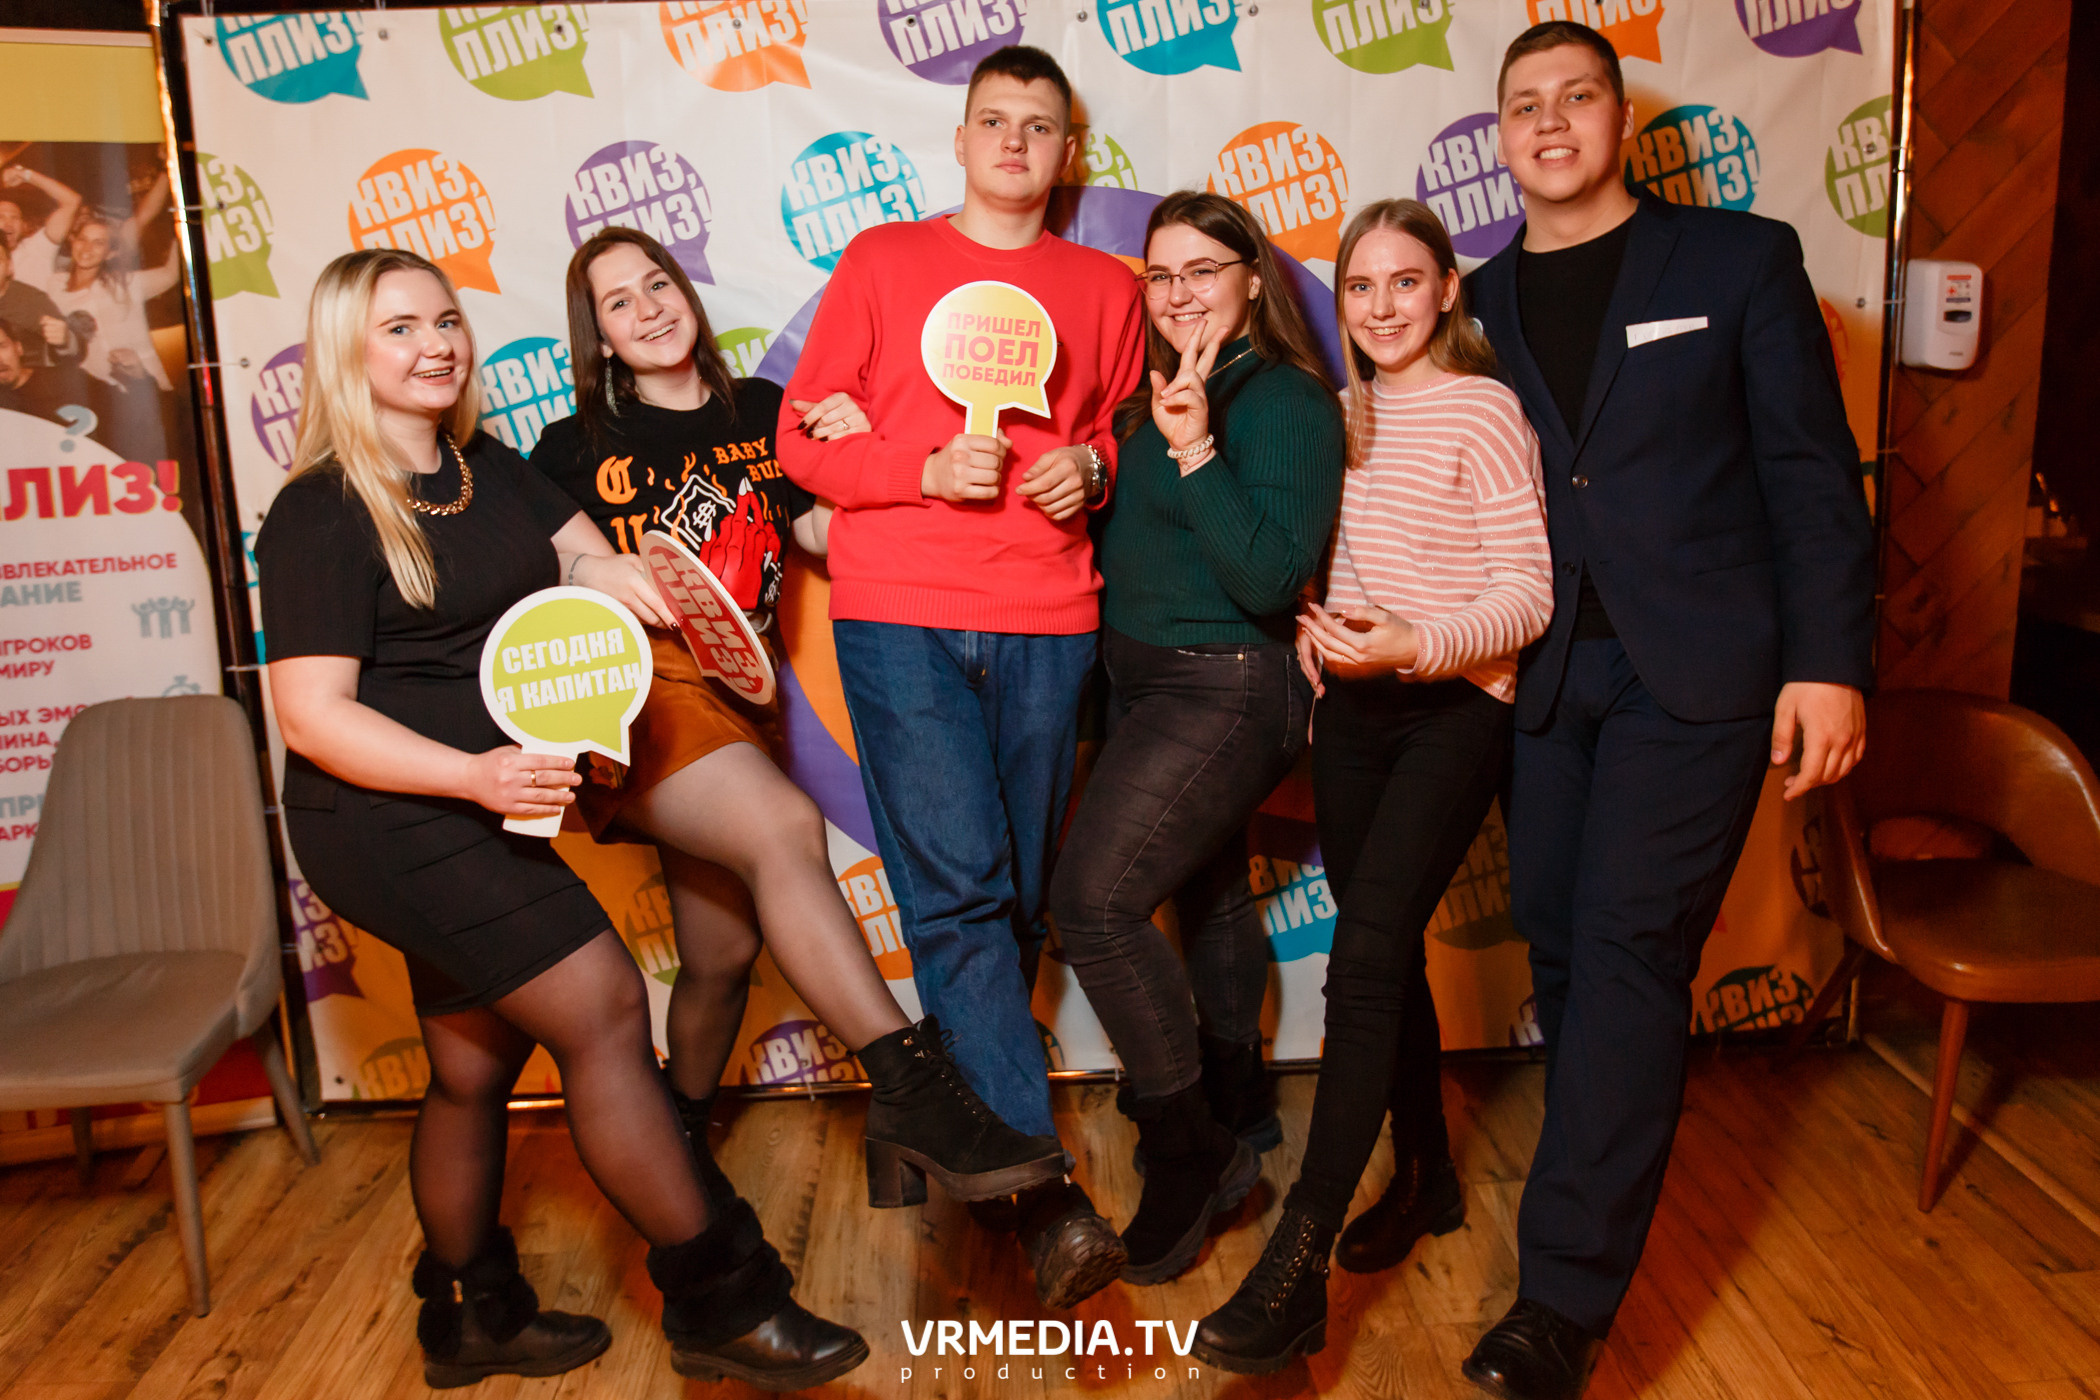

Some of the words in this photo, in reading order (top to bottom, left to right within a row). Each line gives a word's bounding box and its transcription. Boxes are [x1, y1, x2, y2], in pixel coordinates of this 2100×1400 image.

[567, 144, 697, 221] КВИЗ,
[782, 135, 912, 211] КВИЗ,
[1420, 123, 1507, 192] КВИ
[1647, 149, 1760, 207] ЛИЗ!
[351, 152, 479, 230] КВИЗ,
[1237, 167, 1348, 236] ЛИЗ!
[1426, 172, 1525, 236] ПЛИ
[944, 333, 1039, 368] ПОЕЛ
[947, 312, 1041, 338] ПРИШЕЛ
[942, 363, 1036, 387] ПОБЕДИЛ
[712, 436, 769, 464] BABY
[0, 460, 182, 521] ЛИЗ!
[0, 553, 177, 580] ВЛЕКАТЕЛЬНОЕ
[0, 634, 92, 656] ГРОКОВ
[502, 628, 625, 674] СЕГОДНЯ
[497, 686, 517, 714] Я
[520, 663, 641, 710] КАПИТАН
